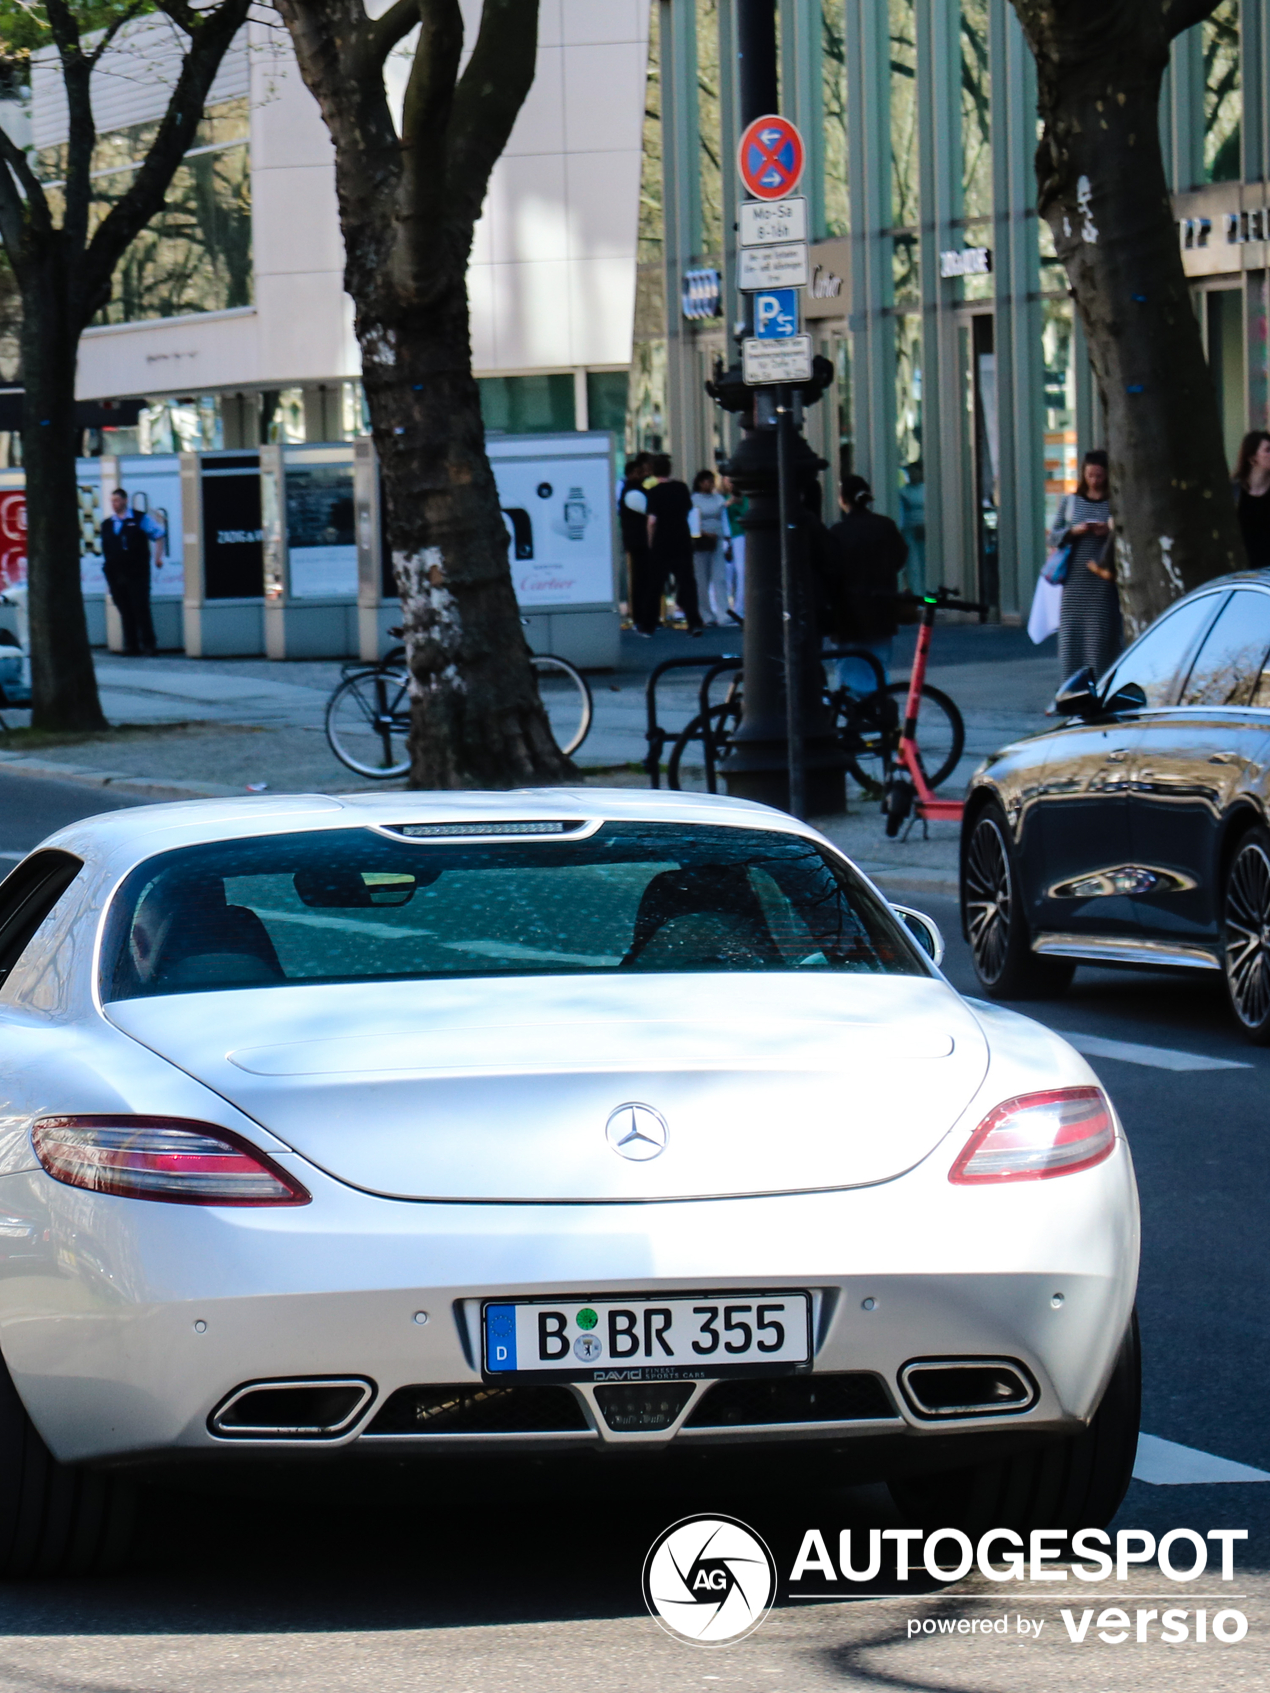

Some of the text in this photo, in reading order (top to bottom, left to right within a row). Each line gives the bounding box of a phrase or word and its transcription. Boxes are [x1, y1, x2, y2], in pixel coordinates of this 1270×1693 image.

[752, 205, 793, 220] Mo-Sa
[520, 575, 576, 591] Cartier
[496, 1304, 785, 1361] D B BR 355
